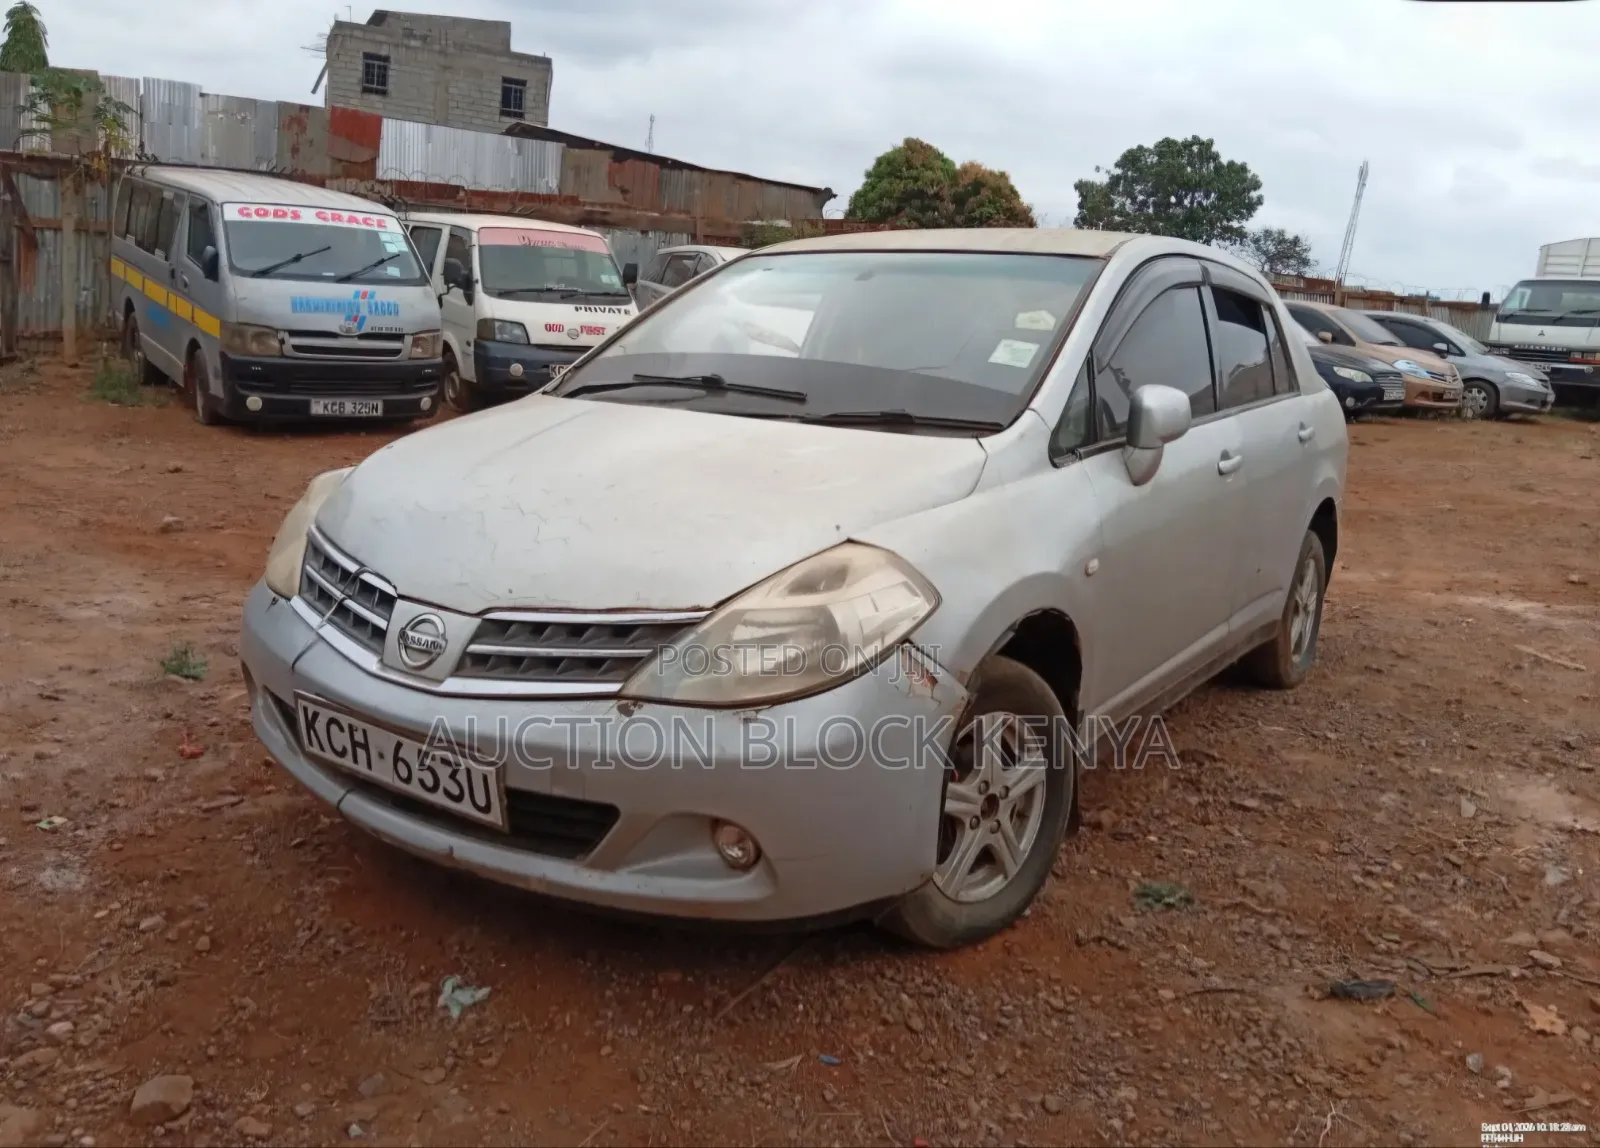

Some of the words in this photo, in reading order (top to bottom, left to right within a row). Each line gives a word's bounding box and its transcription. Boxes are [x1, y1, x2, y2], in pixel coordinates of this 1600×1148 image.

[315, 210, 388, 229] GRACE
[574, 305, 632, 316] PRIVATE
[302, 705, 373, 772] KCH
[393, 740, 492, 815] 653U
